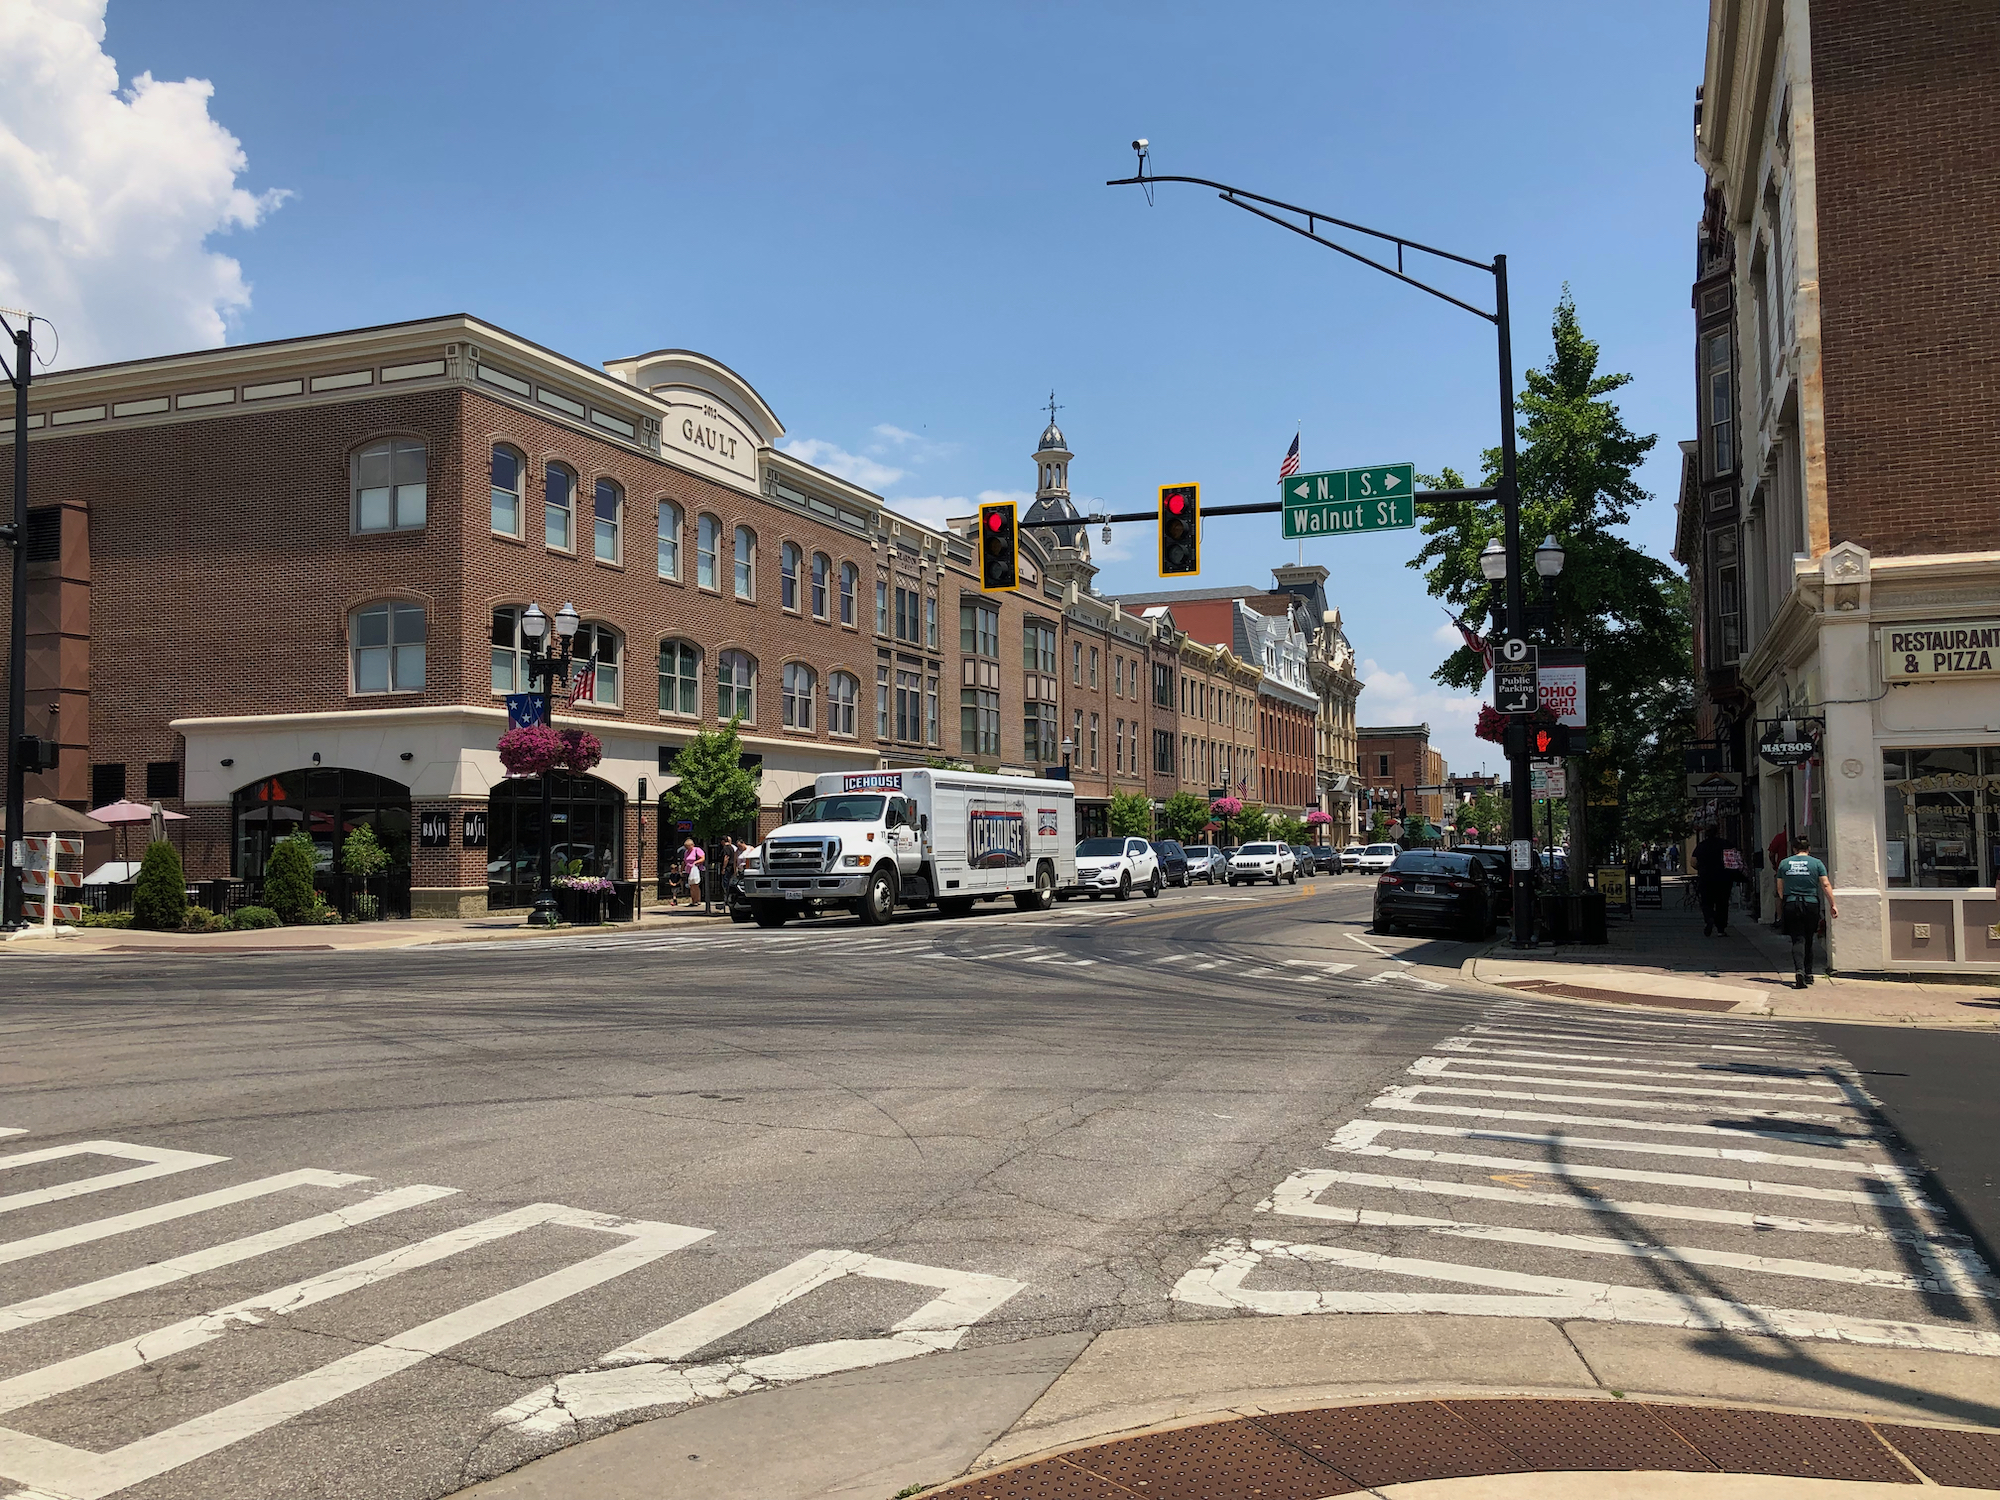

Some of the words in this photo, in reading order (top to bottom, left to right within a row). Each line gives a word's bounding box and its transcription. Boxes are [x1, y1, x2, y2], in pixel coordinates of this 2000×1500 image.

[682, 418, 737, 460] GAULT
[1317, 476, 1334, 500] N.
[1360, 472, 1377, 496] S.
[1293, 504, 1363, 533] Walnut
[1376, 501, 1403, 526] St.
[1892, 628, 2000, 653] RESTAURANT
[1509, 643, 1522, 658] P
[1904, 653, 1919, 673] &
[1933, 651, 1992, 672] PIZZA
[1502, 676, 1530, 685] Public
[1498, 684, 1534, 694] Parking
[1539, 686, 1577, 698] OHIO
[1761, 742, 1812, 753] MATSOS
[845, 776, 901, 791] ICEHOUSE
[1896, 772, 2000, 798] MATSOS
[1903, 803, 2000, 815] Restaurant
[973, 819, 1022, 859] ICEHOUSE
[1930, 829, 1971, 839] Greek
[1638, 885, 1659, 893] spoon
